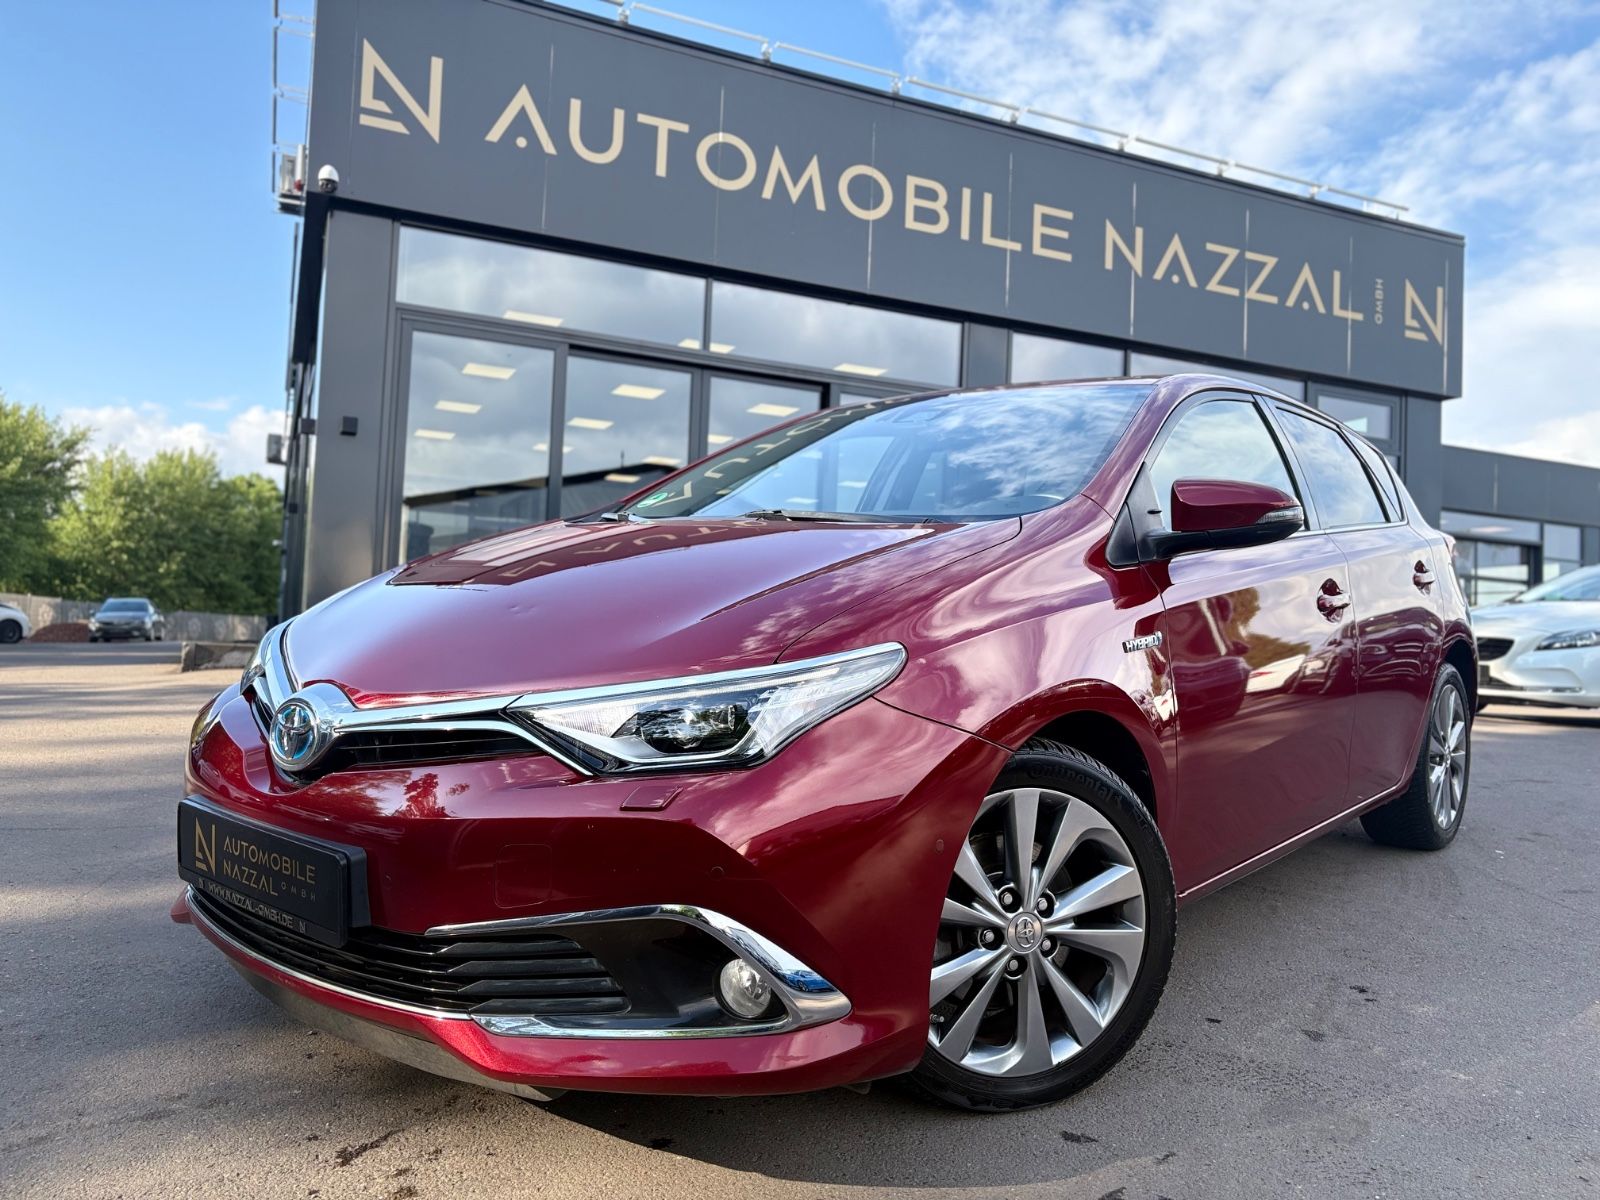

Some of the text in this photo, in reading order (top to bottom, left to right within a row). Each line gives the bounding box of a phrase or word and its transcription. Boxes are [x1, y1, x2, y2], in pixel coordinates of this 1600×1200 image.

[484, 83, 1074, 262] AUTOMOBILE
[1104, 218, 1364, 321] NAZZAL
[1123, 632, 1161, 653] HYBRID
[223, 835, 316, 885] AUTOMOBILE
[223, 858, 279, 896] NAZZAL
